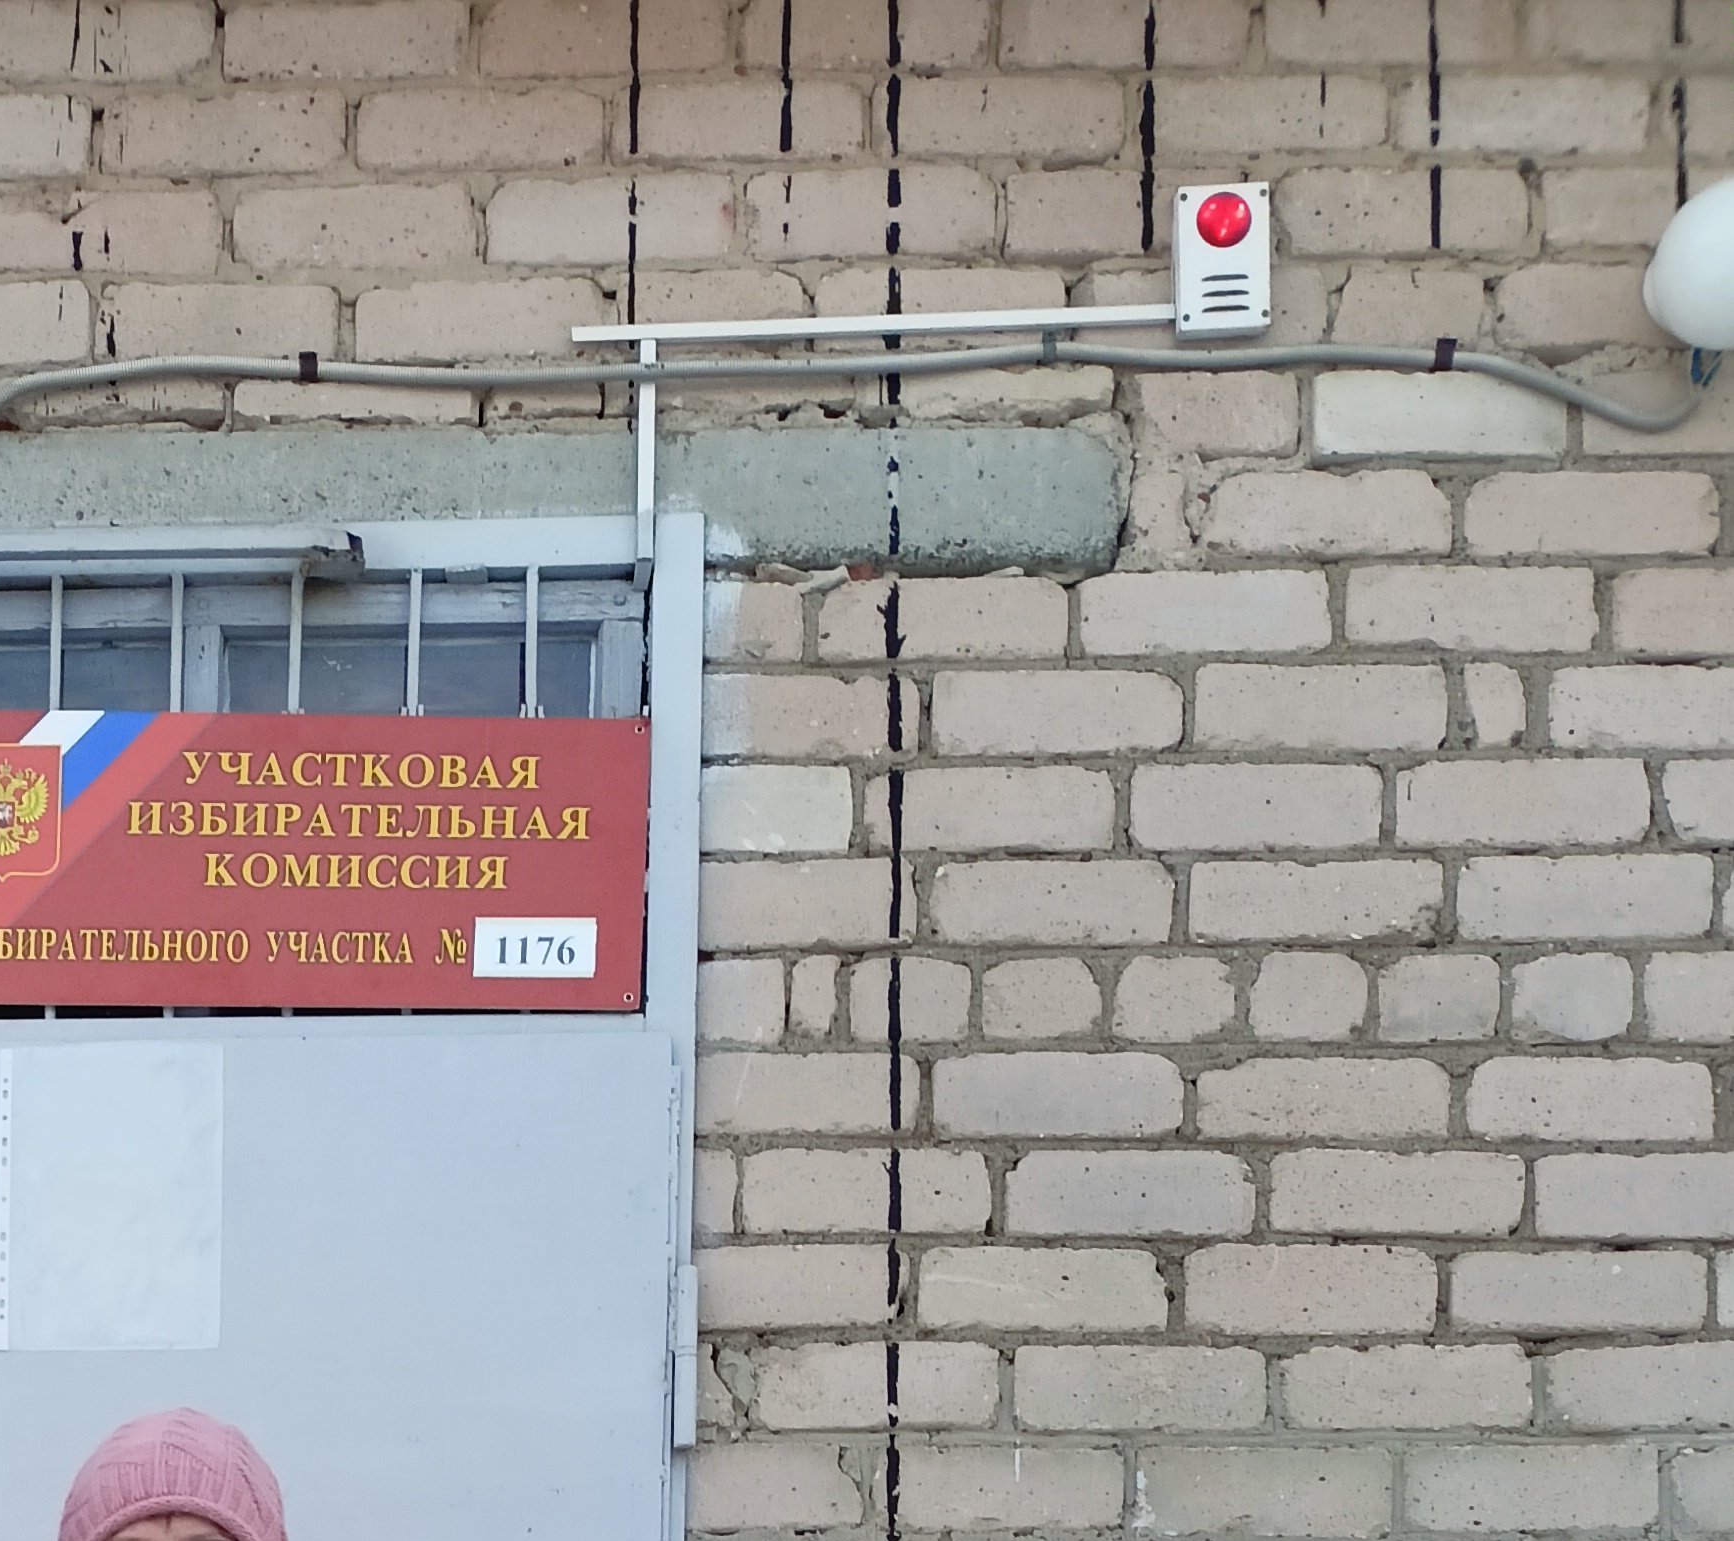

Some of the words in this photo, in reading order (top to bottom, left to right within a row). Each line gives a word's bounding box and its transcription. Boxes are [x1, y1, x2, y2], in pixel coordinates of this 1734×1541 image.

[183, 750, 540, 789] УЧАСТКОВАЯ
[127, 800, 591, 840] ИЗБИРАТЕЛЬНАЯ
[204, 852, 508, 890] КОМИССИЯ
[267, 930, 413, 965] УЧАСТКА
[434, 928, 466, 965] №
[495, 934, 576, 967] 1176
